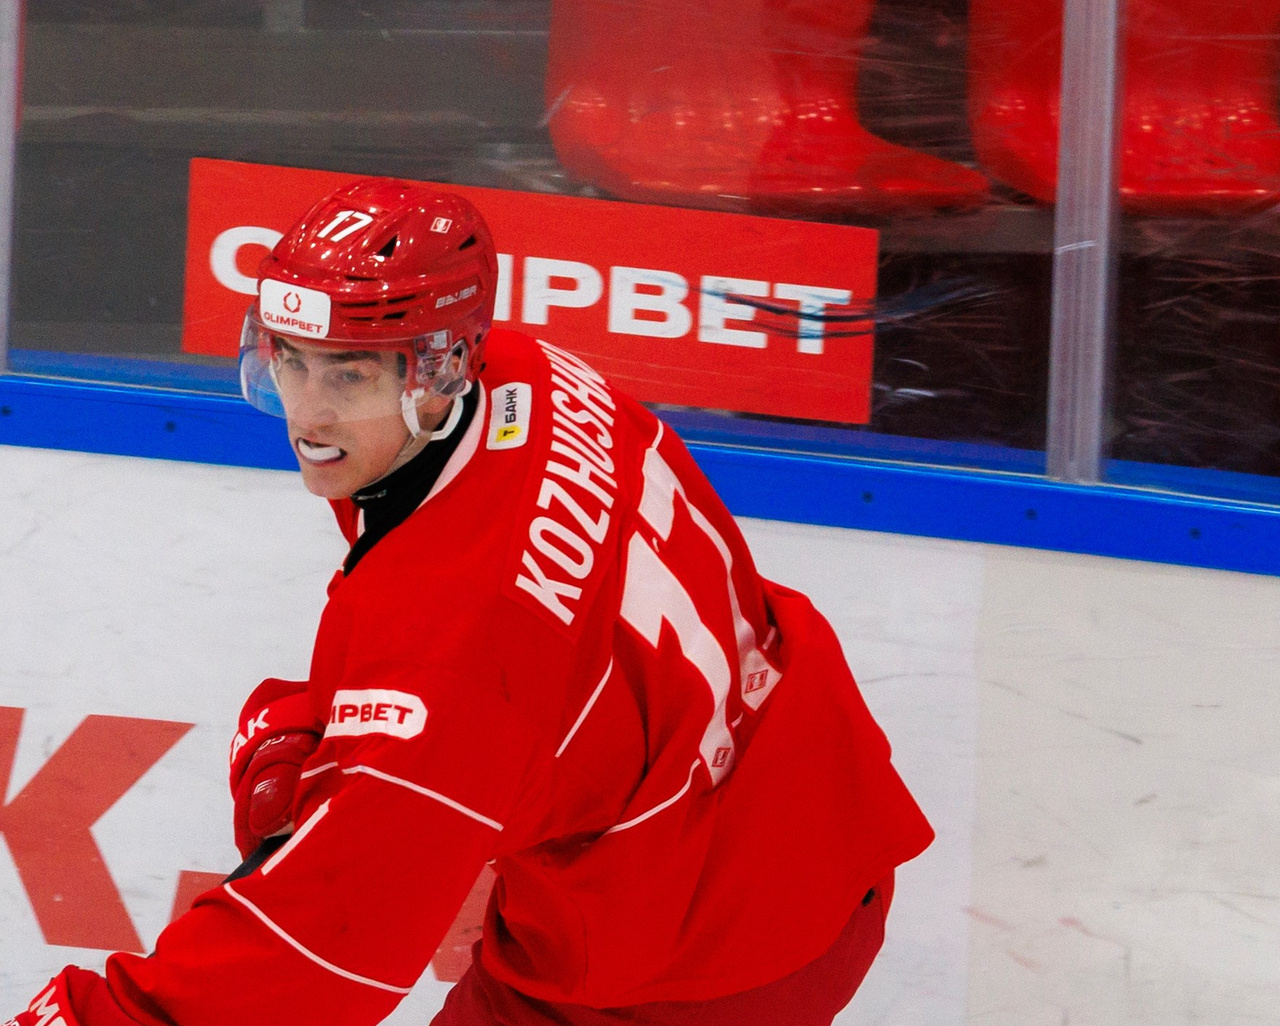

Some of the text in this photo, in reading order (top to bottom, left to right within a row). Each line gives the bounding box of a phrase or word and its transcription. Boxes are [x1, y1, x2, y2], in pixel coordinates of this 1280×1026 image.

[317, 210, 374, 242] 17
[209, 226, 852, 355] OPBET
[263, 311, 323, 334] OLIMPBET
[505, 388, 517, 423] БАНК
